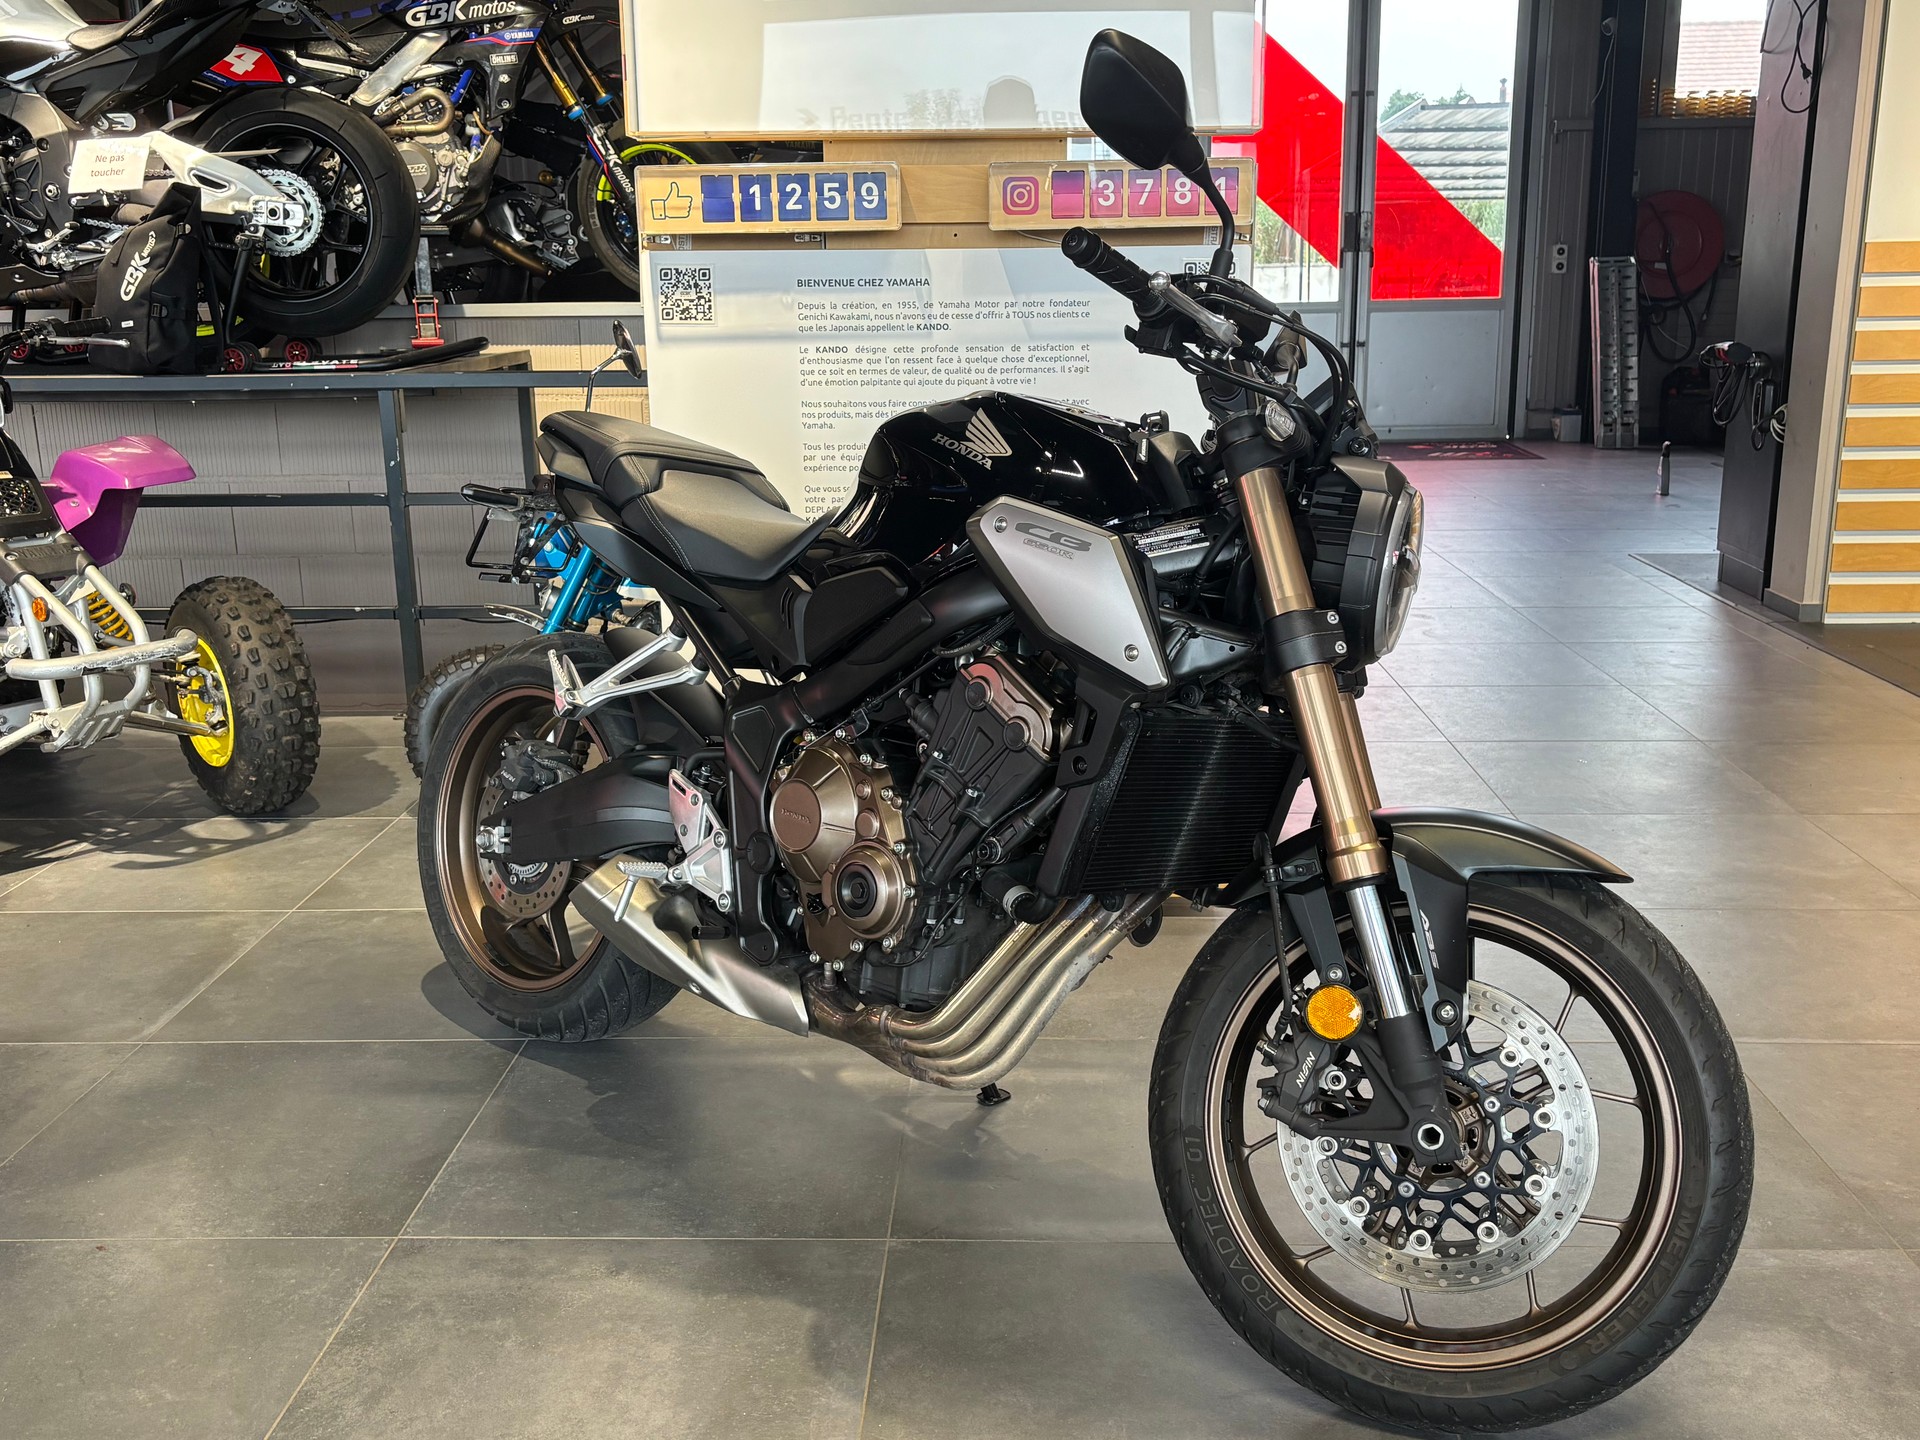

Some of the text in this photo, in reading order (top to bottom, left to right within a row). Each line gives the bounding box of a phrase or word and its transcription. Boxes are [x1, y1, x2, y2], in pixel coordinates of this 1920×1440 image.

[405, 0, 516, 27] GBK motos
[223, 46, 263, 75] 4
[95, 154, 125, 164] Ne pas
[90, 168, 125, 177] toucher
[612, 166, 634, 193] motos
[120, 252, 150, 301] GBK
[141, 236, 156, 258] MOTOS
[797, 302, 825, 311] Depuis
[841, 301, 877, 310] création,
[897, 301, 919, 309] 1955,
[829, 312, 872, 321] Kawakami,
[828, 324, 864, 333] Japonais
[866, 323, 905, 332] appellent
[854, 345, 886, 354] désigne
[920, 344, 958, 354] profonde
[964, 355, 998, 365] quelque
[1027, 354, 1089, 364] d'exceptionnel,
[902, 366, 929, 375] valeur,
[943, 366, 972, 376] qualité
[999, 365, 1057, 375] performances.
[1067, 365, 1089, 375] s'agit
[860, 378, 901, 387] palpitante
[903, 378, 915, 387] qui
[917, 378, 943, 387] ajoute
[957, 377, 987, 387] piquant
[817, 410, 853, 420] produits,
[837, 442, 867, 452] produit
[932, 433, 993, 470] HONDA
[840, 453, 863, 462] équip
[803, 464, 847, 473] expérience
[804, 485, 820, 494] Que
[1015, 522, 1092, 551] CB
[1420, 909, 1440, 970] ABS
[1186, 1136, 1204, 1162] 01
[1590, 1213, 1698, 1355] METZELER
